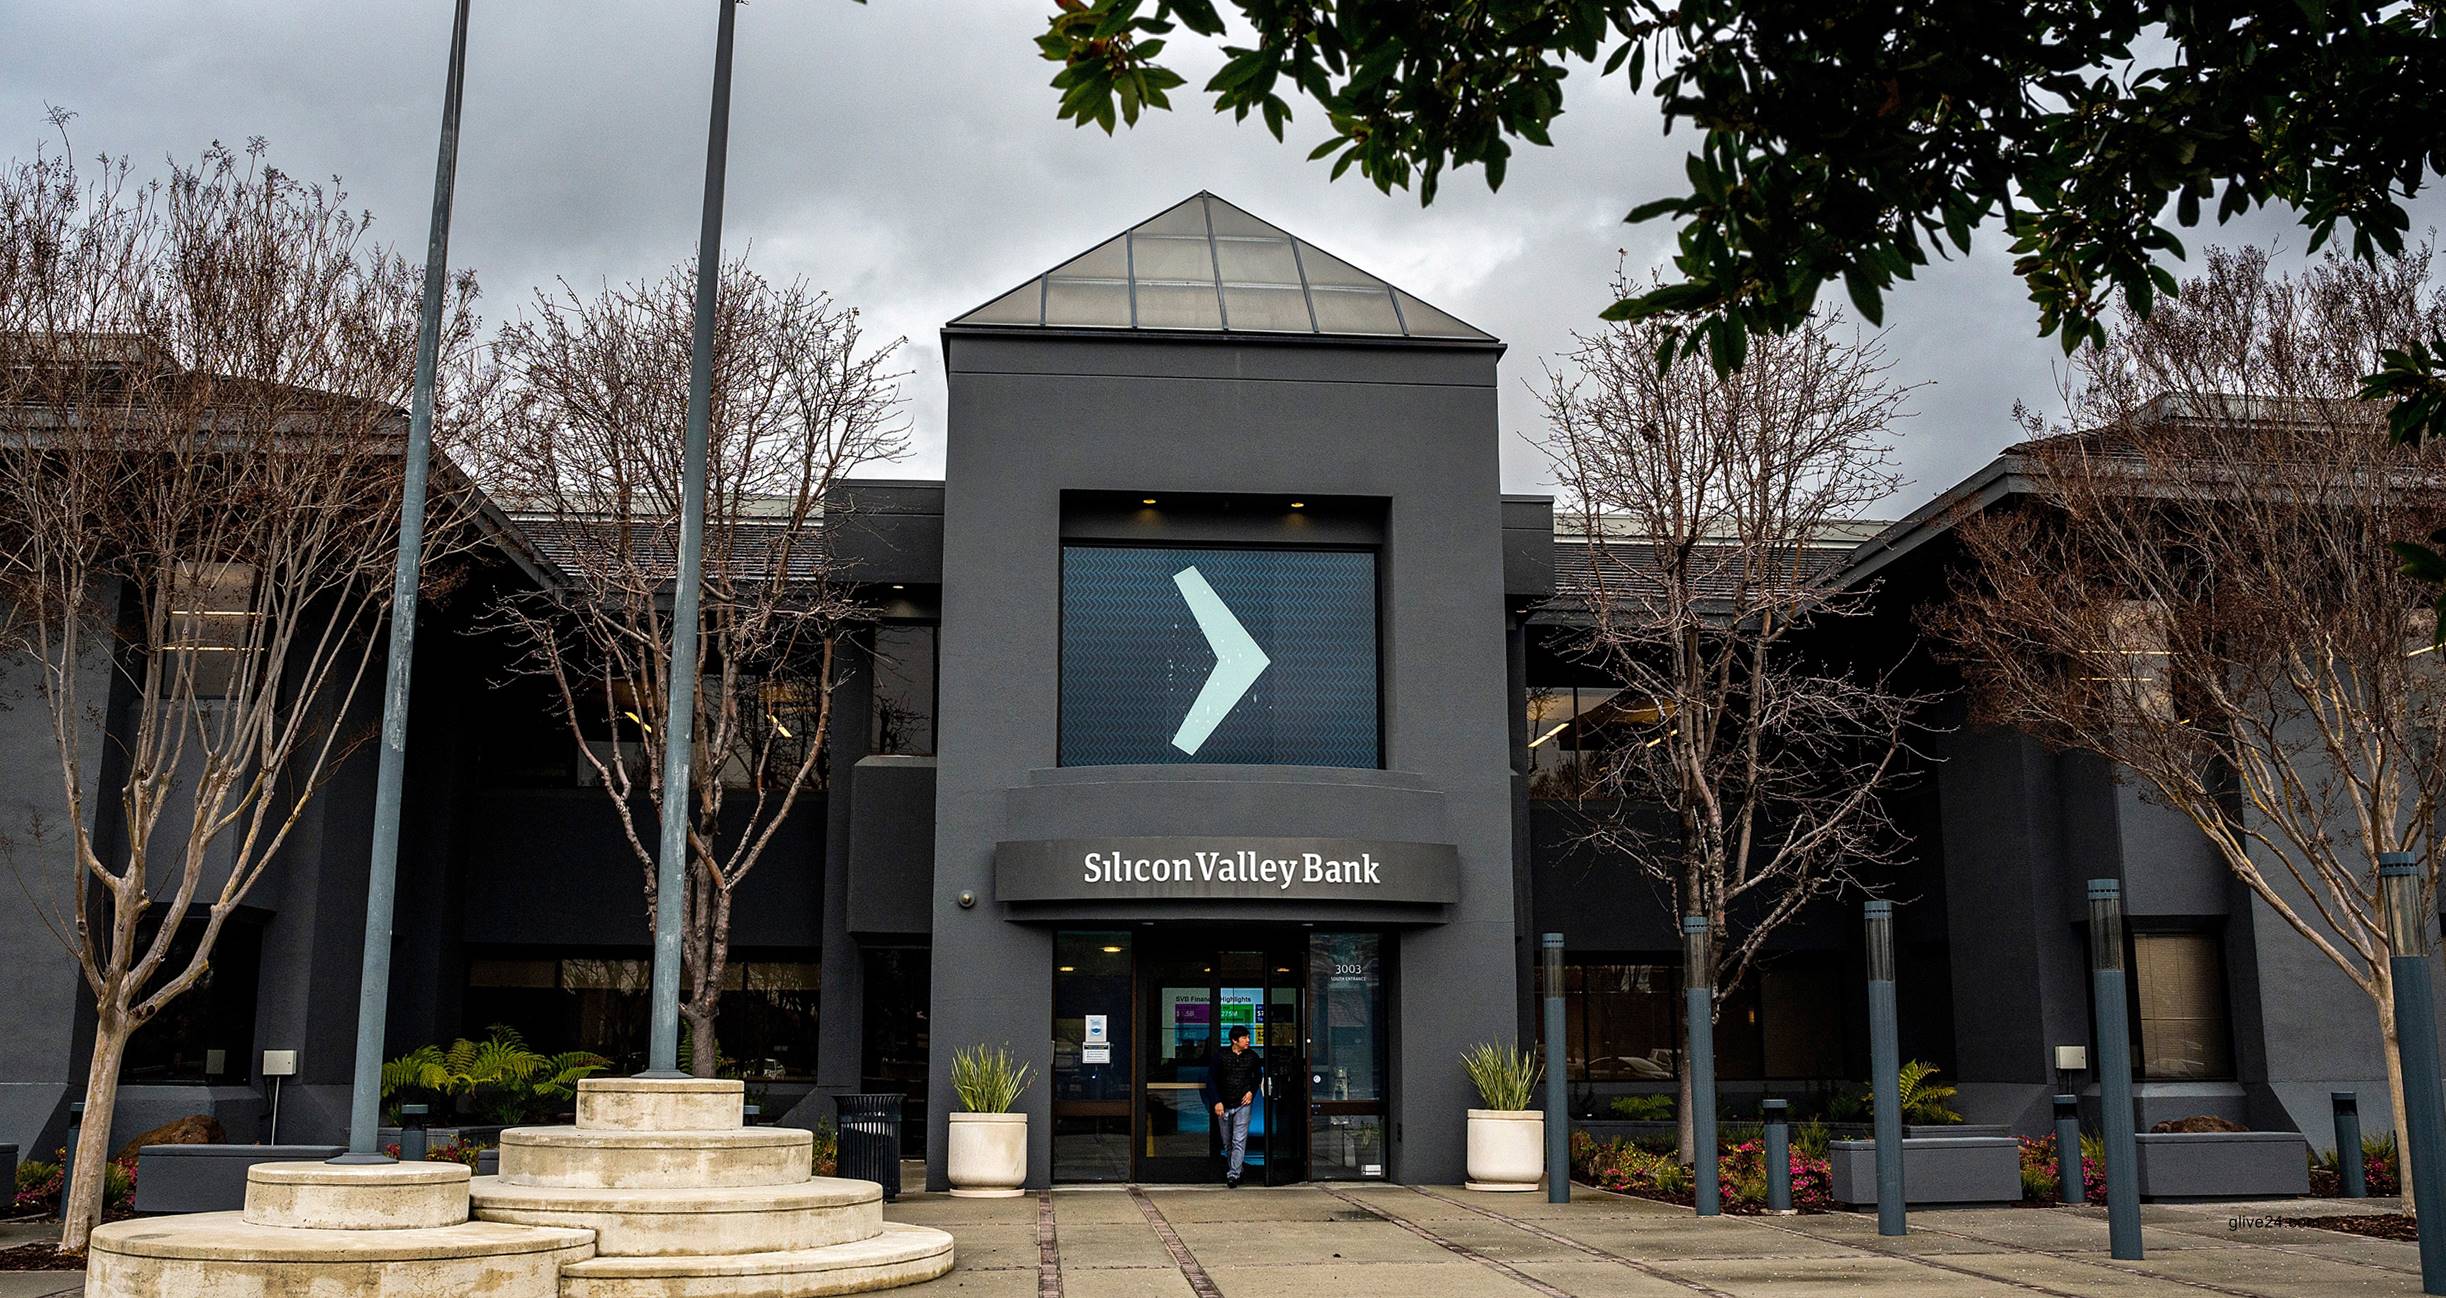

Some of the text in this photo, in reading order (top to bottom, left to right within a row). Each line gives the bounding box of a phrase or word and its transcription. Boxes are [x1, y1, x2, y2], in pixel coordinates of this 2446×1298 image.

[1084, 851, 1381, 890] Silicon Valley Bank
[1335, 964, 1362, 975] 3003
[1175, 995, 1189, 1003] SVB
